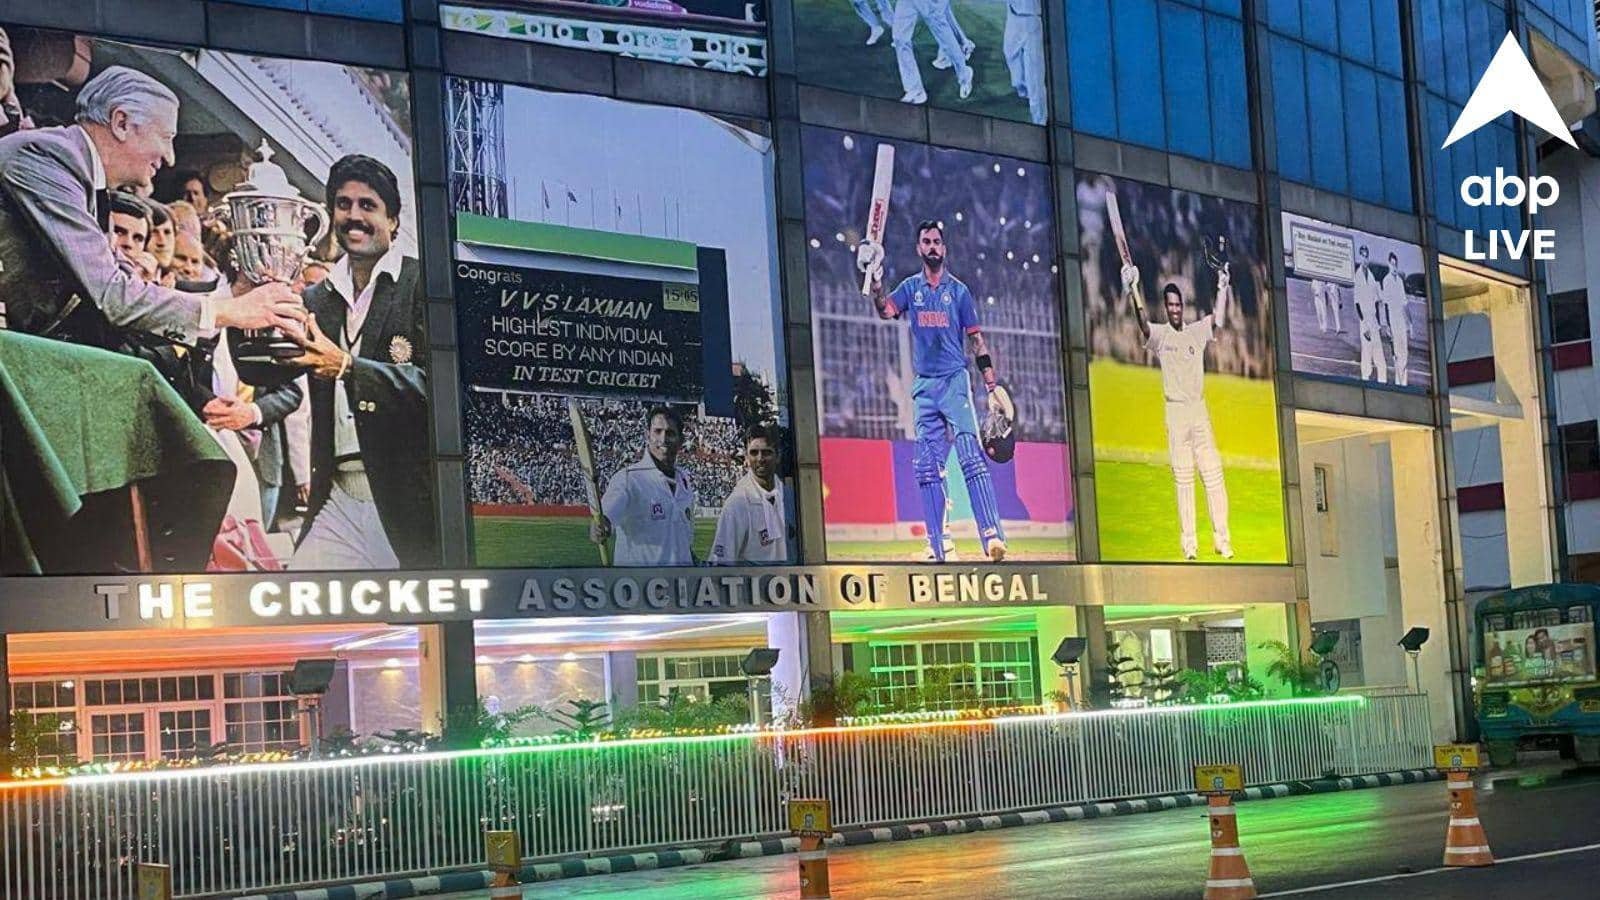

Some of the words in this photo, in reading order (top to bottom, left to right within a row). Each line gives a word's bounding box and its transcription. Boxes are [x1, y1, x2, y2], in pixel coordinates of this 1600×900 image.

[457, 264, 522, 284] Congrats
[563, 296, 653, 320] LAXMAN
[918, 311, 950, 328] INDIA
[491, 315, 572, 338] HIGHEST
[575, 323, 668, 346] INDIVIDUAL
[484, 338, 548, 358] SCORE
[552, 343, 576, 361] BY
[579, 346, 616, 363] ANY
[619, 349, 673, 367] INDIAN
[512, 365, 535, 381] IN
[538, 366, 584, 384] TEST
[587, 370, 661, 388] CRICKET
[95, 581, 214, 620] THE
[249, 578, 490, 617] CRICKET
[518, 574, 819, 611] ASSOCIATION
[840, 573, 889, 605] OF
[909, 572, 1048, 602] BENGAL
